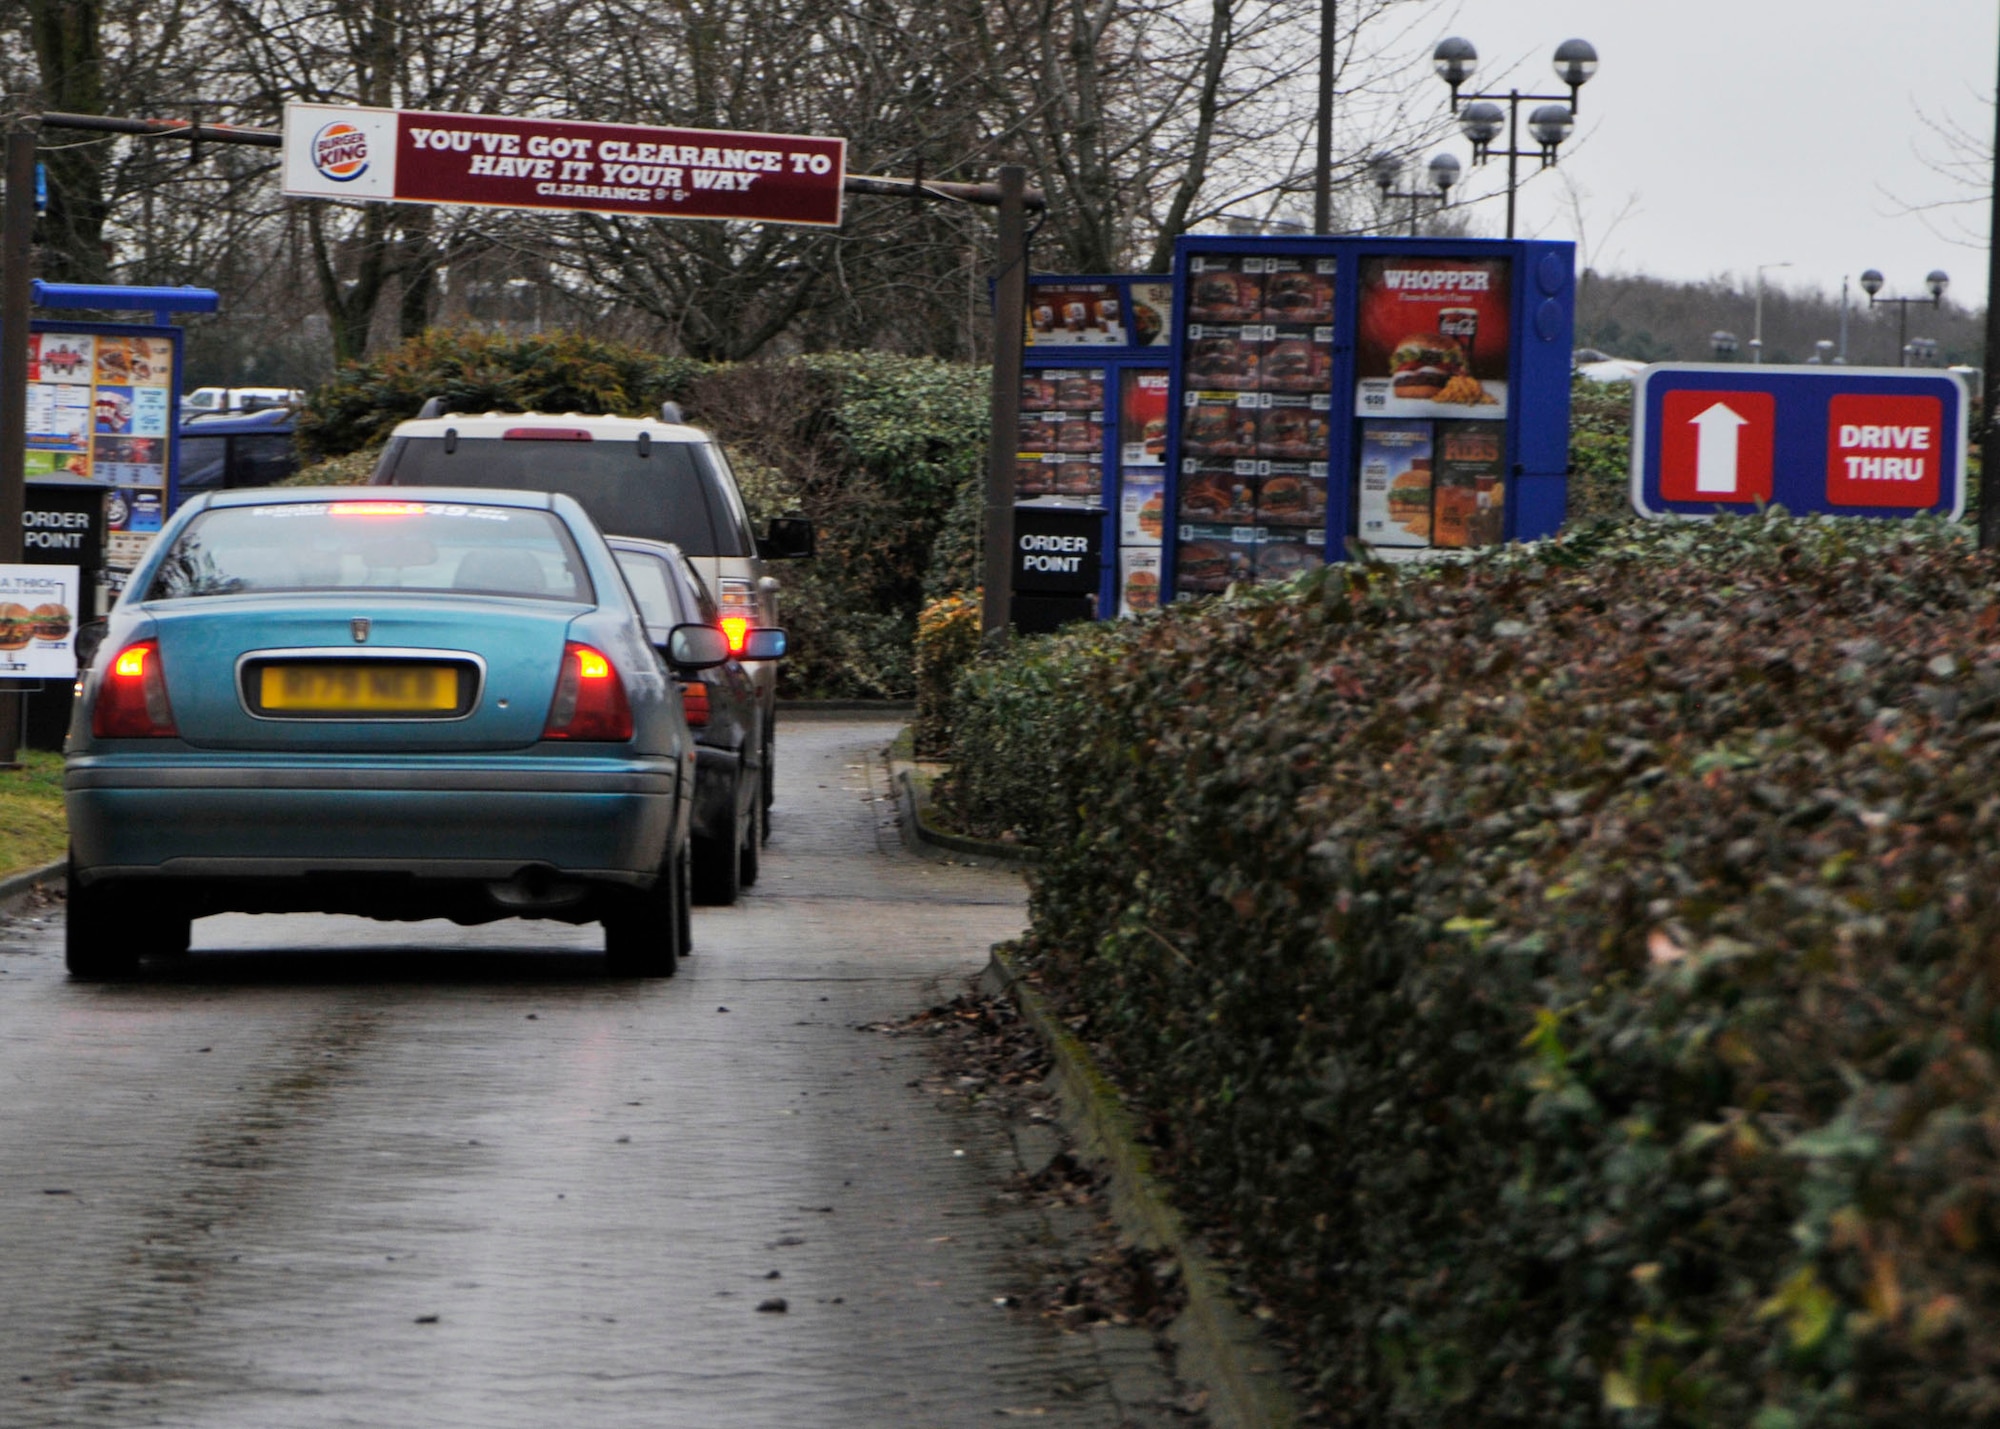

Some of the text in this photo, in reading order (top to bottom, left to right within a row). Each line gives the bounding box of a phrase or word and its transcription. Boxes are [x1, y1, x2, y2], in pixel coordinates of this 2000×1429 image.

[318, 133, 366, 152] BURGER
[409, 128, 832, 174] YOU'VE GOT CLEARANCE TO
[318, 144, 367, 168] KING
[468, 155, 760, 191] HAVE IT YOUR WAY
[536, 182, 650, 201] CLEARANCE
[1383, 270, 1490, 290] WHOPPER
[1840, 425, 1931, 449] DRIVE
[1845, 456, 1925, 481] THRU
[22, 510, 90, 528] ORDER
[25, 532, 83, 548] POINT
[1019, 535, 1088, 553] ORDER
[1023, 555, 1082, 572] POINT
